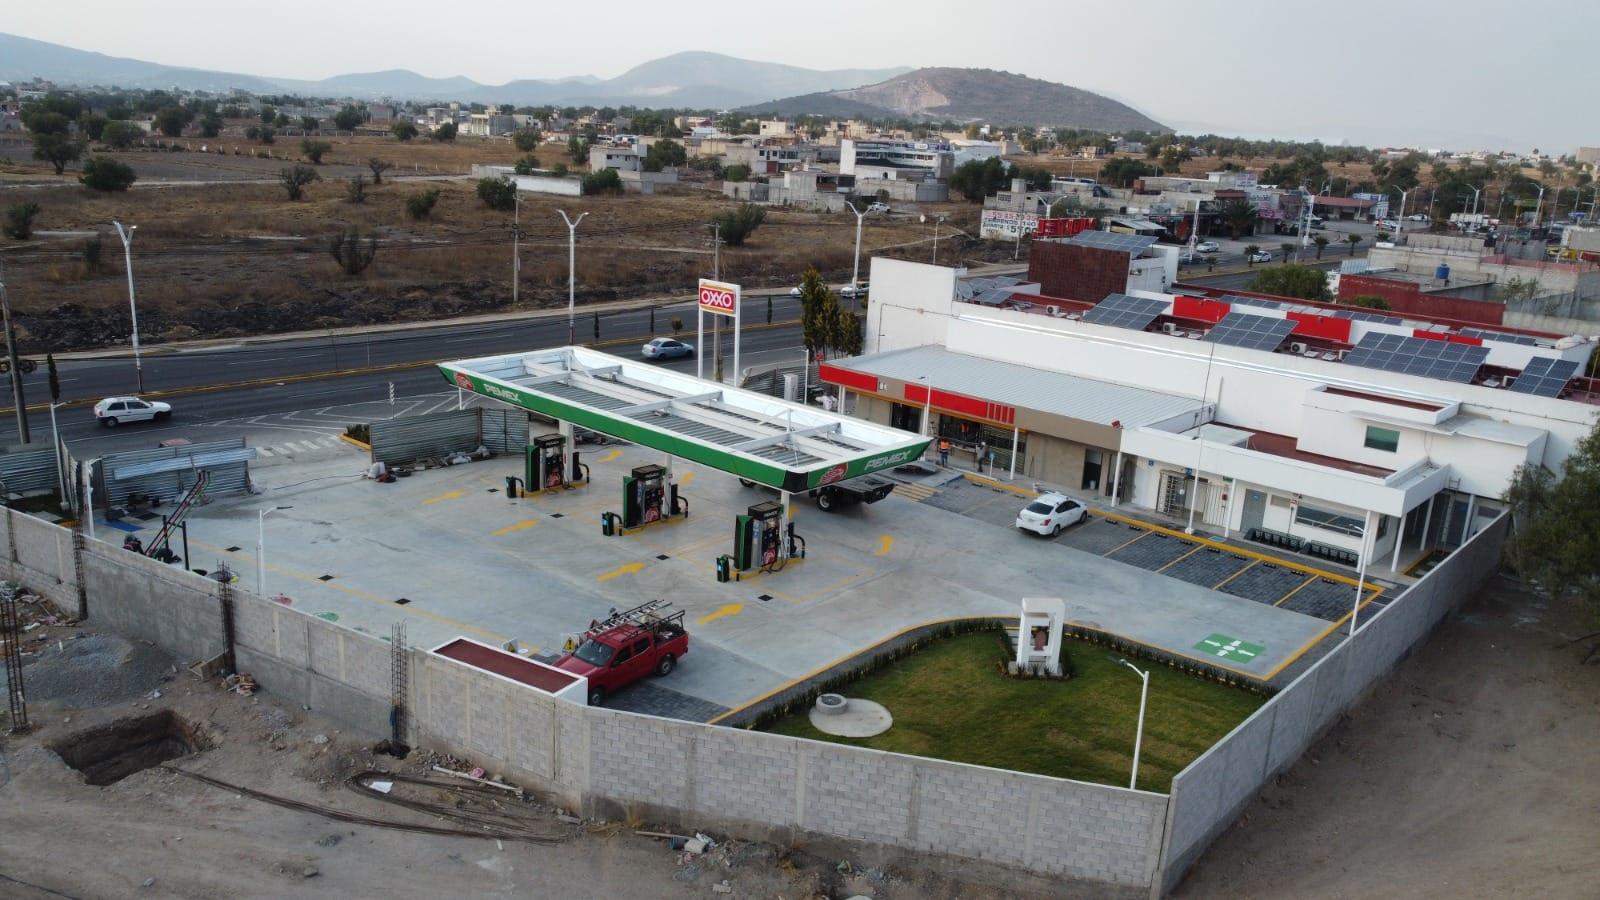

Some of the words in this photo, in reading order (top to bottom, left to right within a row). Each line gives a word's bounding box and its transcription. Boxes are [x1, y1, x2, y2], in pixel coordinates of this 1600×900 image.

[701, 290, 732, 307] OXXO
[483, 383, 522, 402] PEMEX
[864, 450, 911, 470] PEMEX
